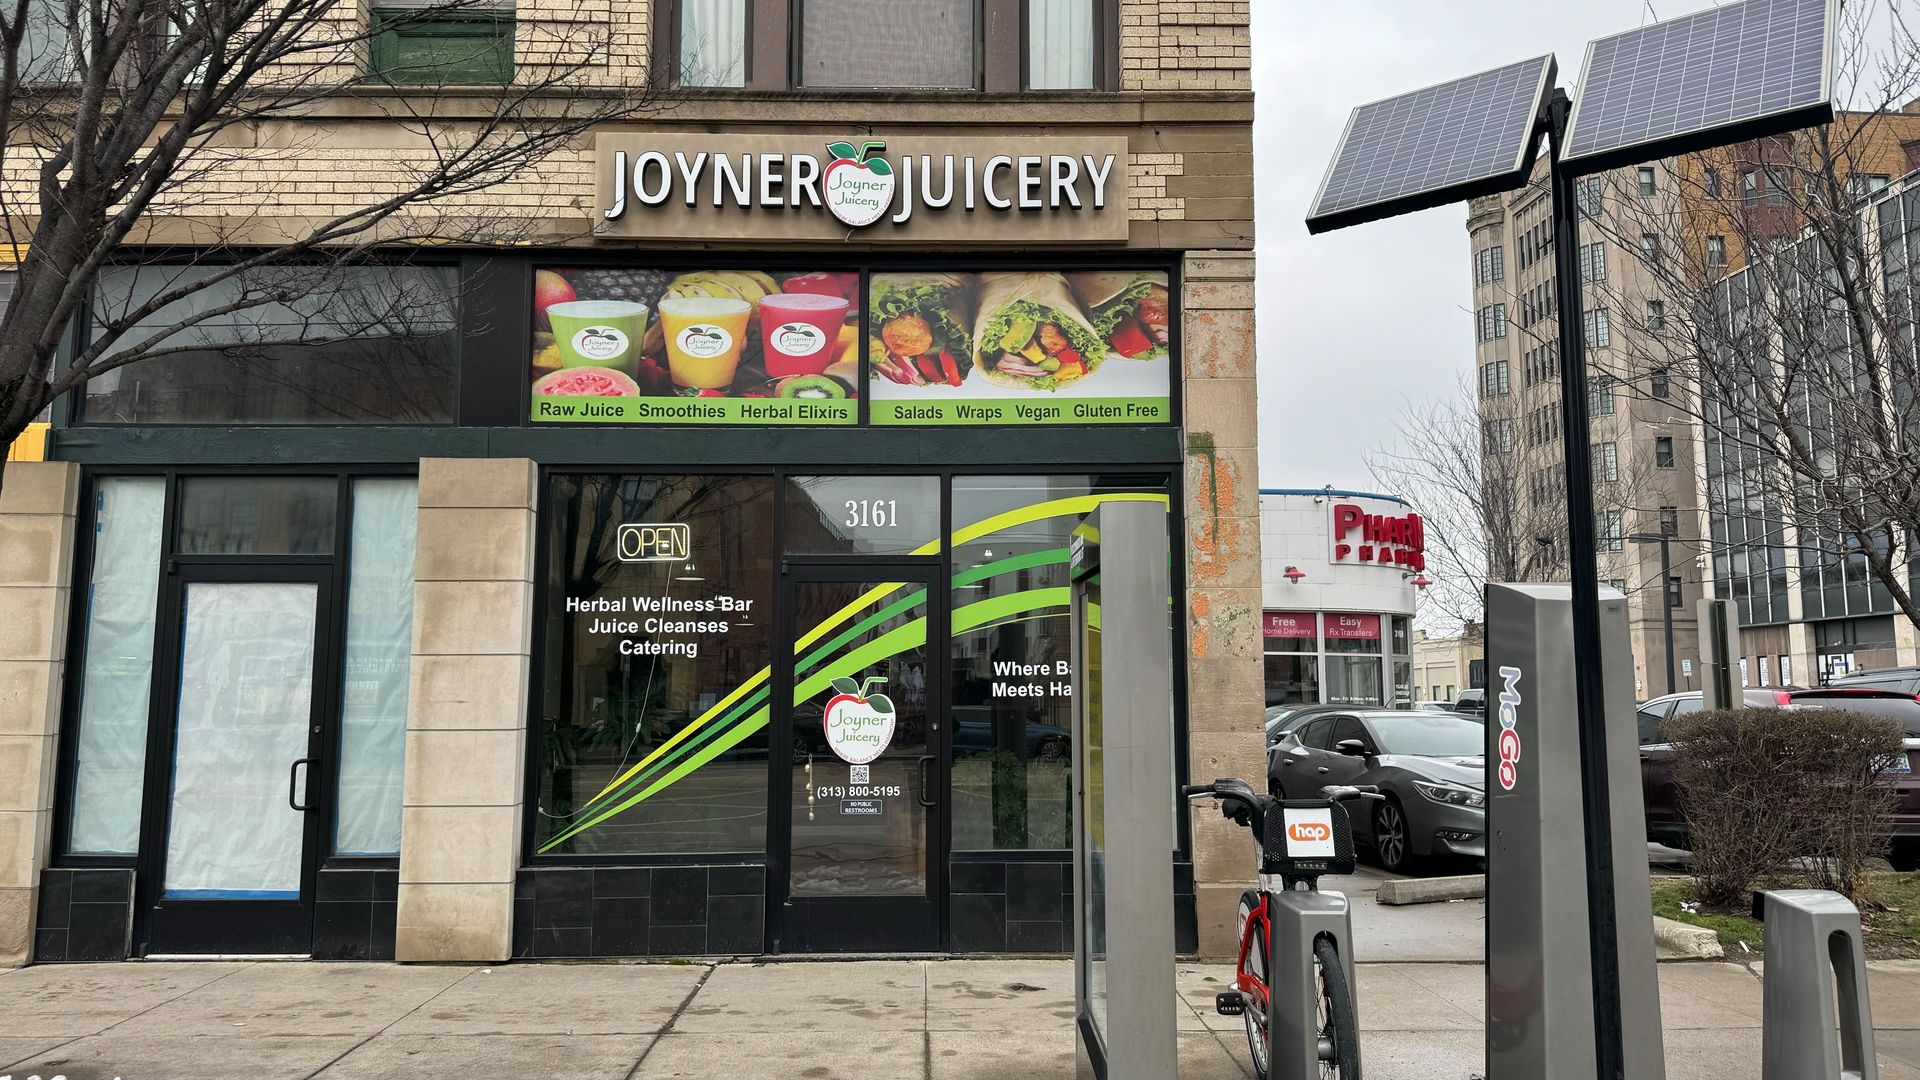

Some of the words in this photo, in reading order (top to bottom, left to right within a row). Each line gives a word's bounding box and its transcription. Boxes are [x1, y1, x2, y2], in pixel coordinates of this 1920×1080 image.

[604, 151, 824, 221] JOYNER
[893, 154, 1116, 225] JUICERY
[830, 172, 887, 195] Joyner
[835, 191, 879, 210] Juicery
[540, 403, 575, 417] Raw
[580, 402, 624, 417] Juice
[639, 403, 726, 418] Smoothies
[741, 404, 793, 418] Herbal
[799, 405, 848, 419] Elixirs
[894, 404, 943, 419] Salads
[956, 405, 1002, 421] Wraps
[1015, 404, 1060, 421] Vegan
[1073, 403, 1122, 418] Gluten
[1126, 403, 1159, 417] Free
[845, 500, 898, 527] 3161
[621, 527, 686, 557] OPEN
[566, 596, 626, 612] Herbal
[632, 596, 715, 612] Wellness
[721, 596, 754, 612] Bar
[588, 618, 639, 634] Juice
[645, 618, 729, 634] Cleanses
[1272, 616, 1296, 626] Free
[1340, 616, 1362, 628] Easy
[1283, 628, 1311, 636] Delivery
[1329, 628, 1339, 636] Rx
[1341, 628, 1373, 637] Transfers
[619, 639, 698, 658] Catering
[993, 661, 1050, 676] Where
[992, 682, 1044, 697] Meets
[830, 709, 887, 731] Joyner
[836, 729, 880, 746] Juicery
[817, 786, 846, 799] (313)
[849, 786, 901, 797] 800-5195
[1295, 823, 1326, 841] hap
